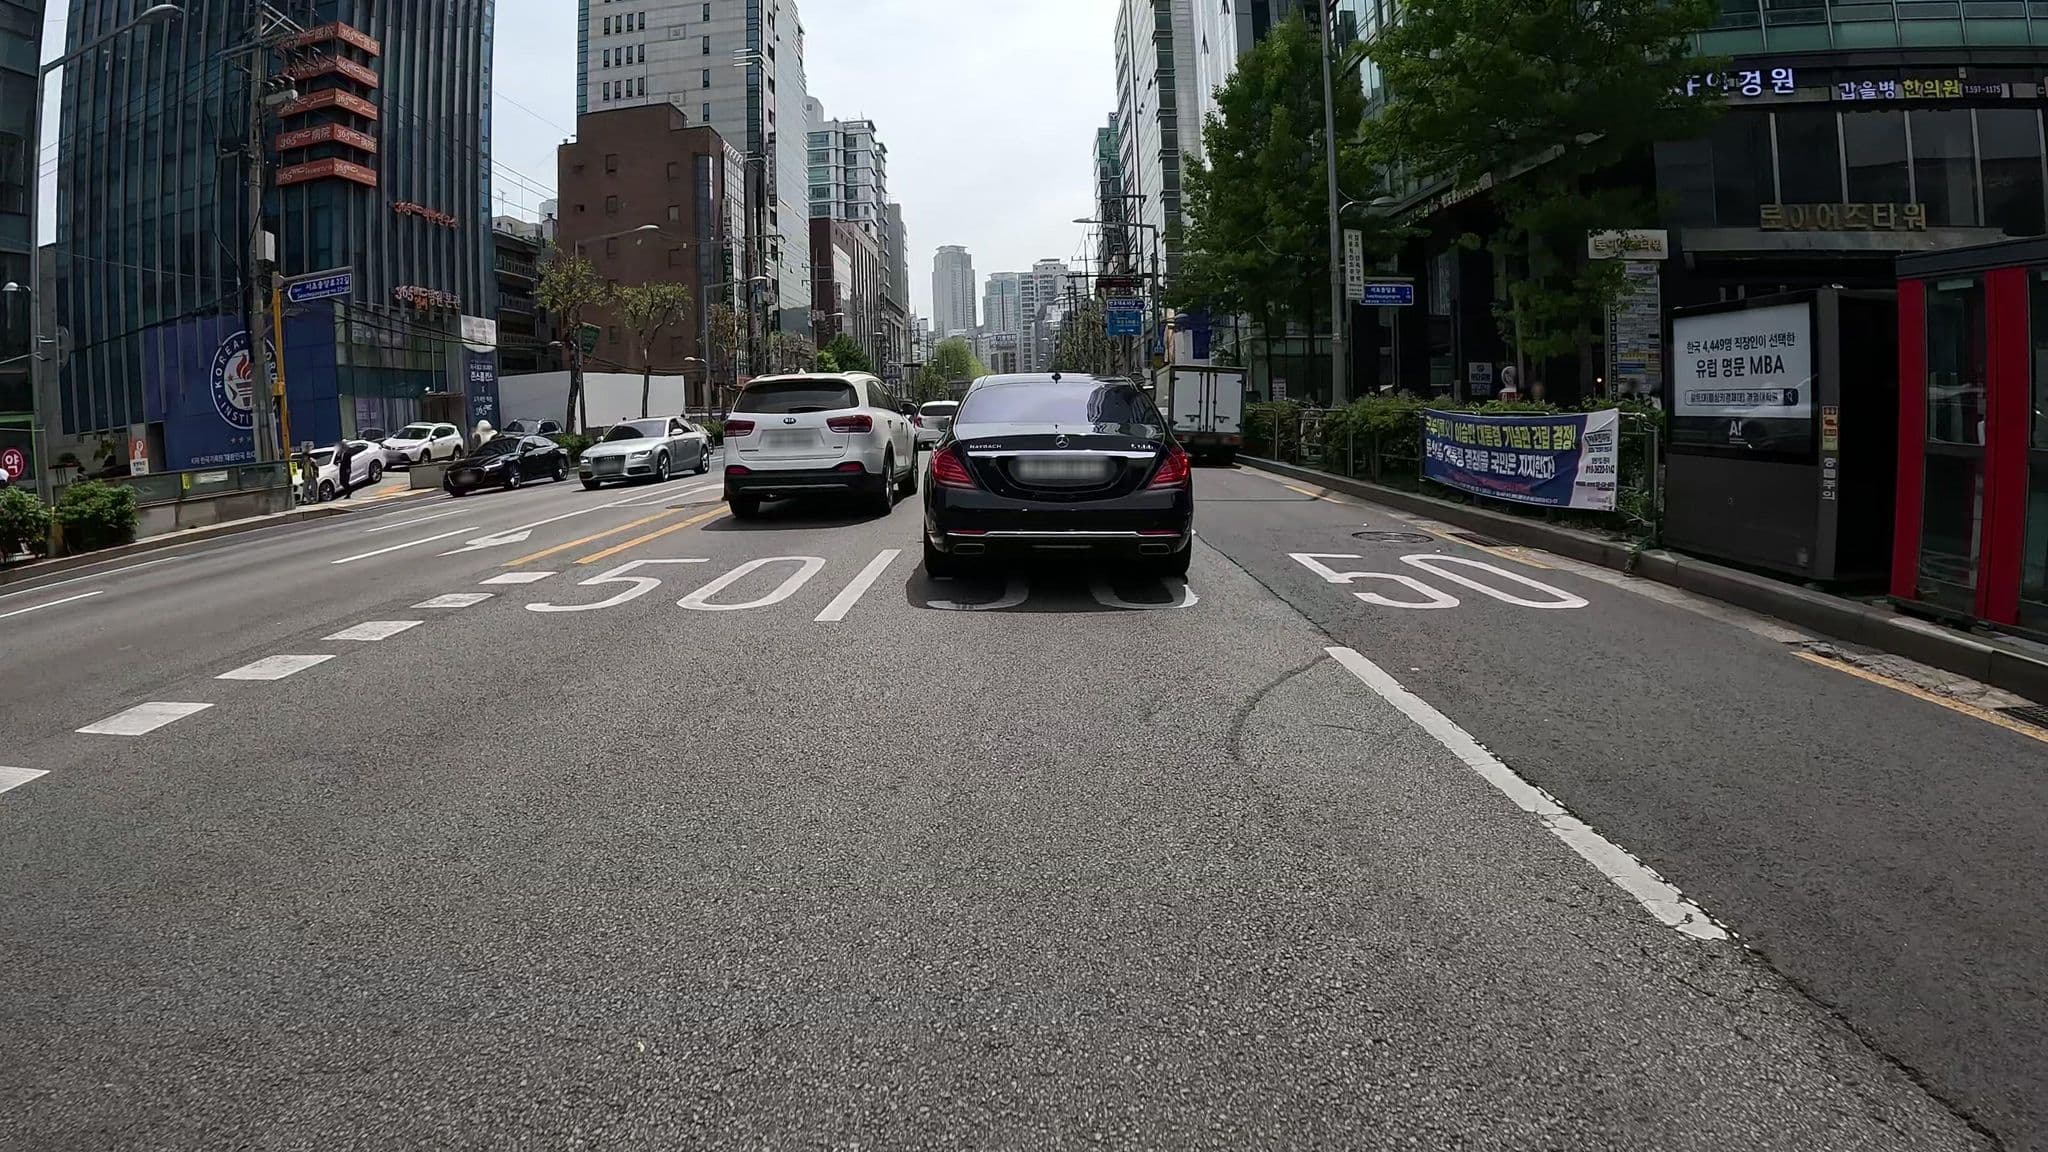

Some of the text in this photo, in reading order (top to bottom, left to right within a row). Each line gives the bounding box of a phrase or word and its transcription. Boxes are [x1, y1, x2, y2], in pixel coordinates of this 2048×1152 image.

[1839, 80, 1895, 100] 갑을병
[1903, 78, 1961, 98] 한의원
[1686, 331, 1796, 355] 한국 4,449명 직장인이 선택한
[214, 338, 240, 390] KOREA
[1695, 354, 1785, 379] 유럽 명문 MBA
[1454, 420, 1476, 445] 이승만
[1477, 424, 1502, 448] 대통령
[1502, 425, 1532, 449] 기념관
[1532, 425, 1550, 450] 건립
[1552, 423, 1577, 450] 결정!
[5, 454, 19, 474] 약
[1465, 448, 1489, 473] 결정을
[1490, 451, 1517, 476] 국민은
[525, 556, 826, 612] 50
[1288, 553, 1590, 610] 50
